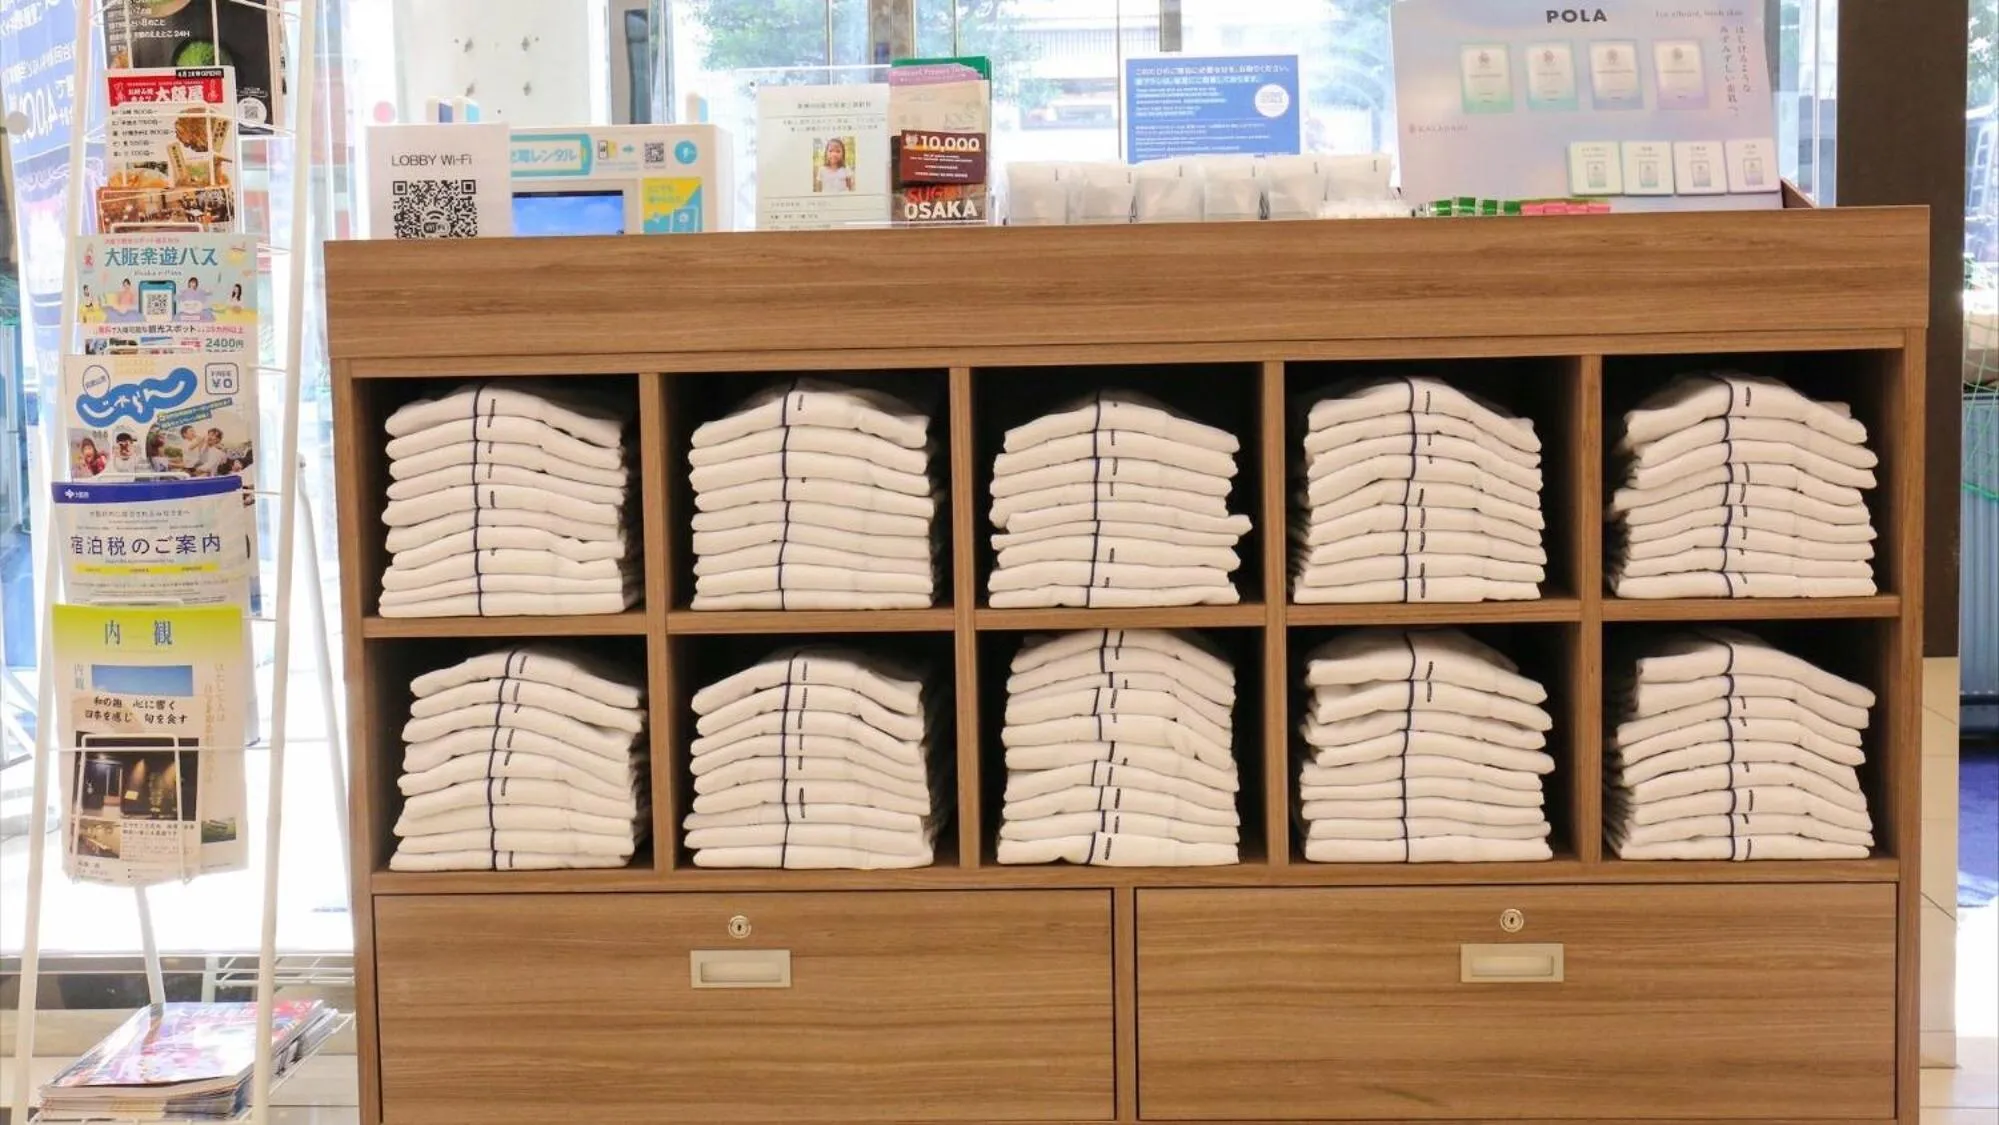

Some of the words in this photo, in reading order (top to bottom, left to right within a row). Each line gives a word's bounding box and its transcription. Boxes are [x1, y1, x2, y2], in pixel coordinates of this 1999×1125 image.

[1545, 9, 1608, 24] POLA
[391, 154, 437, 166] LOBBY
[441, 154, 473, 166] Wi-Fi
[904, 199, 978, 219] OSAKA
[104, 246, 219, 267] 大阪楽遊パス
[205, 337, 244, 348] 2400円
[81, 379, 186, 418] じゃらん
[70, 532, 221, 556] 宿泊税のご案内
[85, 709, 134, 723] 日本を感じ
[144, 713, 189, 725] 旬を食す
